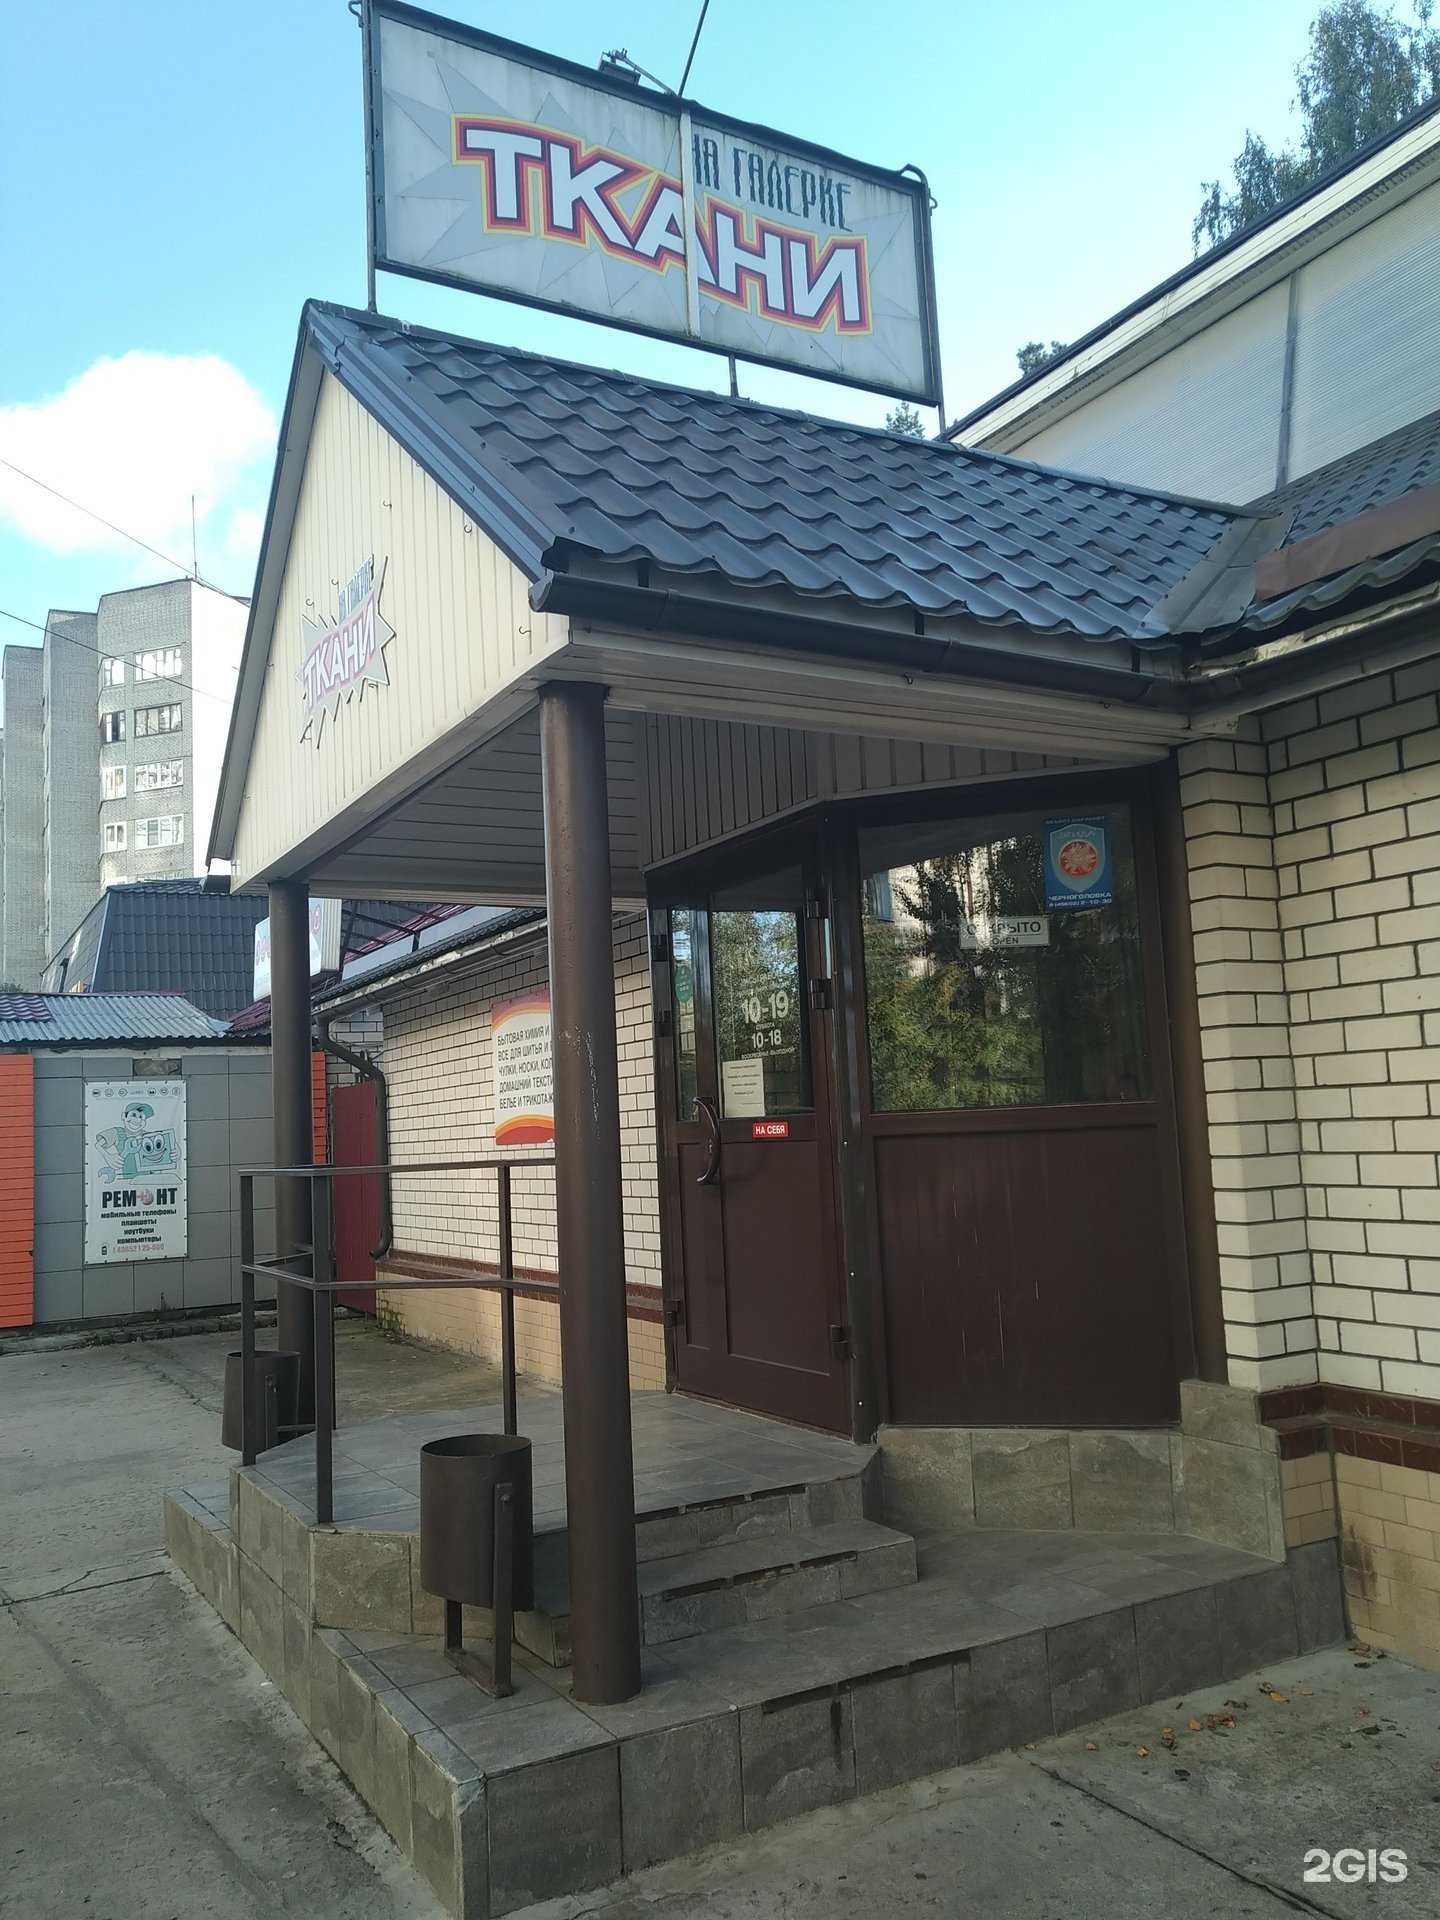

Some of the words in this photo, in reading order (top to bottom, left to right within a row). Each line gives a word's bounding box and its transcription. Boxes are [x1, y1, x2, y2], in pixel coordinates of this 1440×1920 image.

[733, 147, 853, 232] ГАЛЕРКЕ
[457, 121, 868, 330] ТКАНИ
[303, 597, 375, 710] ТКАНИ
[741, 990, 789, 1024] 10-19
[497, 1030, 524, 1046] БЫТОВАЯ
[751, 1029, 782, 1049] 10-18
[498, 1049, 509, 1061] ВСЕ
[510, 1047, 522, 1061] ДЛЯ
[522, 1043, 543, 1057] ШИТЬЯ
[499, 1075, 532, 1093] ДОМАШНИЙ
[500, 1096, 517, 1109] БЕЛЬЕ
[755, 1126, 766, 1135] НА
[767, 1125, 785, 1134] СЕБЯ
[101, 1210, 141, 1219] мобильные
[142, 1208, 177, 1217] телефоны
[117, 1236, 162, 1244] компьютеры
[123, 1227, 155, 1235] ноутбуки
